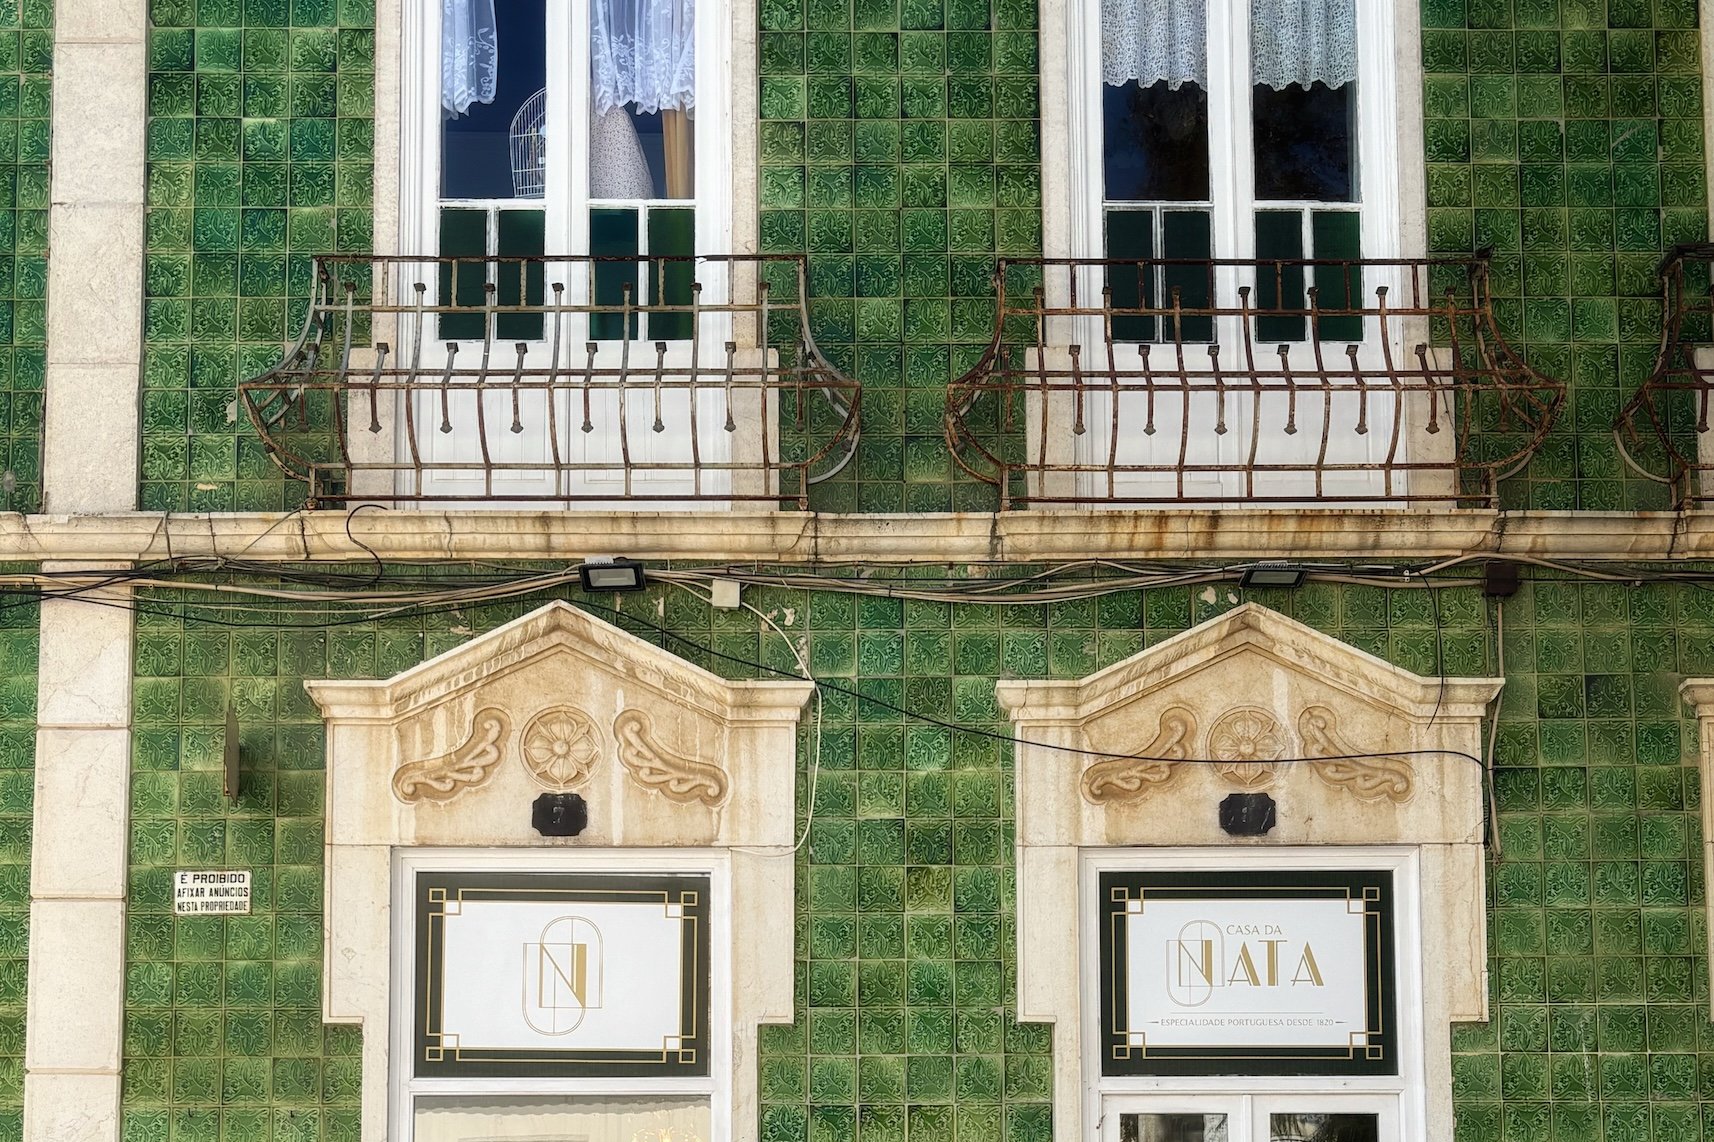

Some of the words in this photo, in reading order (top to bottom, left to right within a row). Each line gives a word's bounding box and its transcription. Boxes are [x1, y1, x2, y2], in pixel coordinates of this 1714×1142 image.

[193, 873, 245, 884] PROIBIDO
[177, 887, 205, 898] AFIXAR
[209, 885, 249, 897] ANÚNCIOS
[177, 901, 198, 912] NESTA
[200, 900, 247, 911] PROPRIEDADE
[1226, 924, 1260, 936] CASA
[1264, 924, 1283, 936] DA
[1166, 938, 1324, 988] NATA
[1160, 1018, 1225, 1026] ESPECIALIDADE
[1228, 1018, 1284, 1026] PORTUGUESA
[1287, 1018, 1313, 1026] DESDE
[1316, 1018, 1334, 1026] 1820
